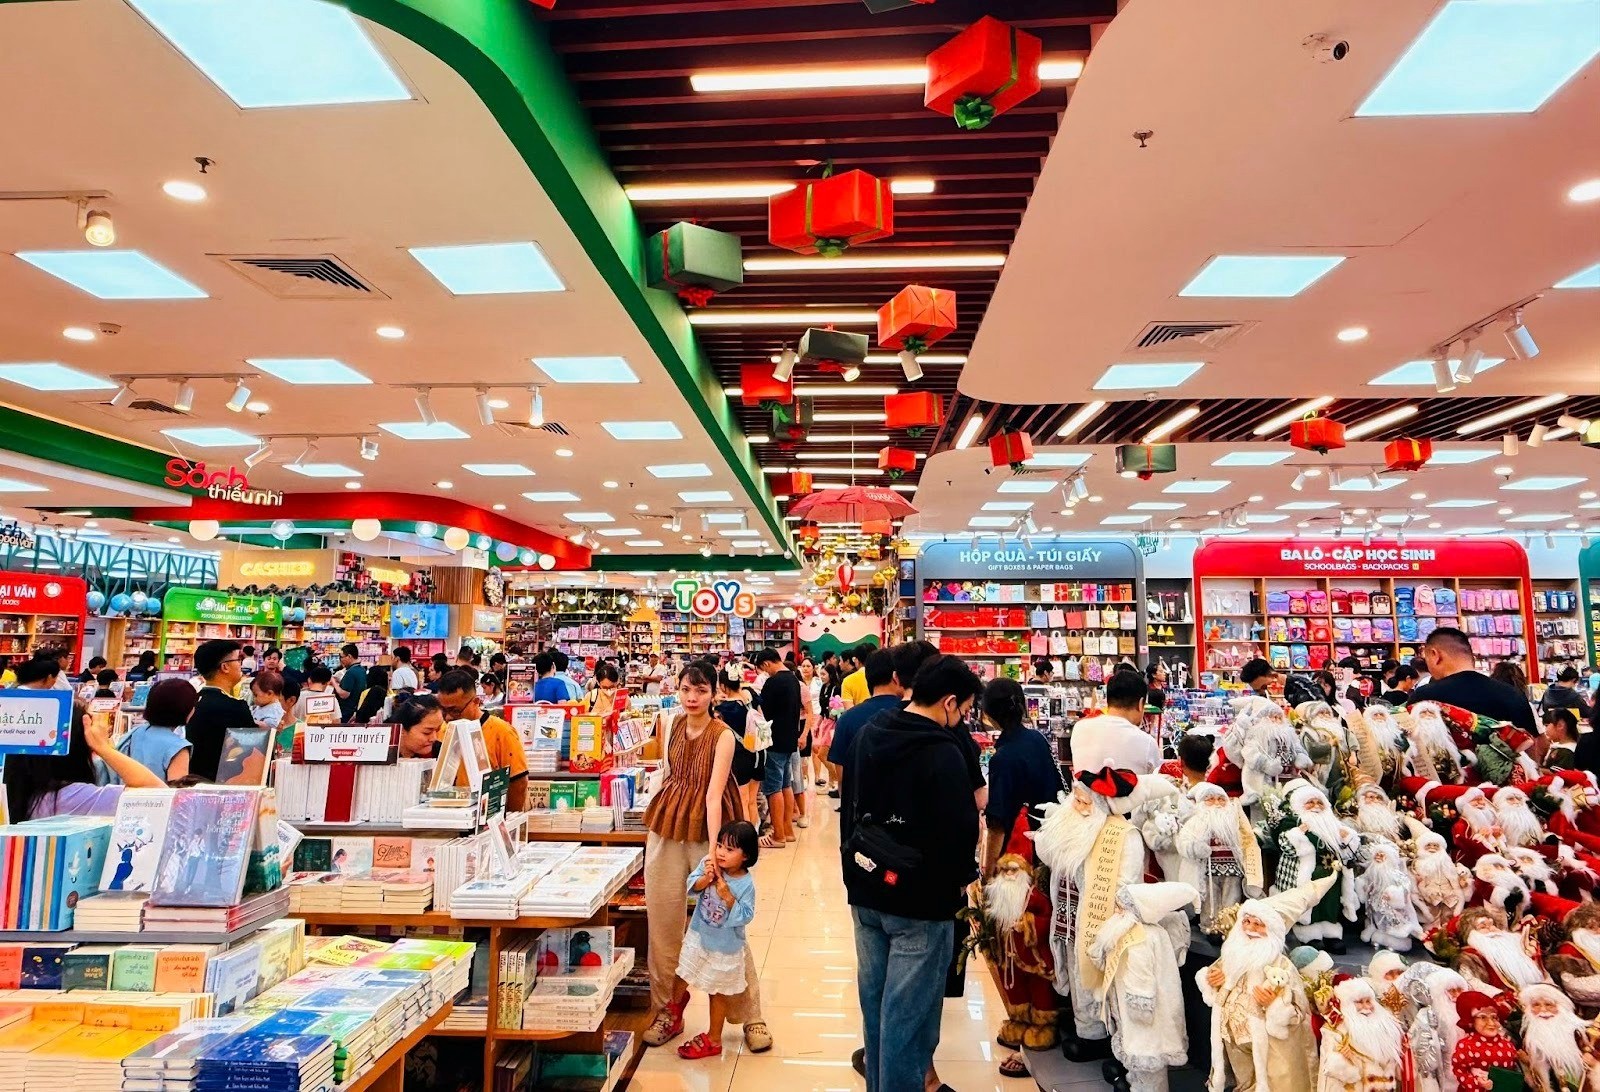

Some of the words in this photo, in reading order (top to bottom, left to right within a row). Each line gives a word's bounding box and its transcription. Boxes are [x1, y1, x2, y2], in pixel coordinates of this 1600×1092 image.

[208, 484, 252, 505] thiếu
[256, 490, 283, 506] nhi
[960, 548, 991, 564] HỘP
[994, 548, 1027, 563] QUÀ
[1036, 548, 1062, 562] TÚI
[1066, 547, 1102, 562] GIẤY
[1280, 549, 1303, 561] BA
[1304, 546, 1324, 561] LÔ
[1331, 546, 1364, 563] CẶP
[1365, 549, 1398, 563] HỌC
[1400, 549, 1435, 561] SINH
[17, 709, 43, 725] Ánh
[310, 733, 325, 743] TOP
[353, 732, 386, 744] THUYẾT
